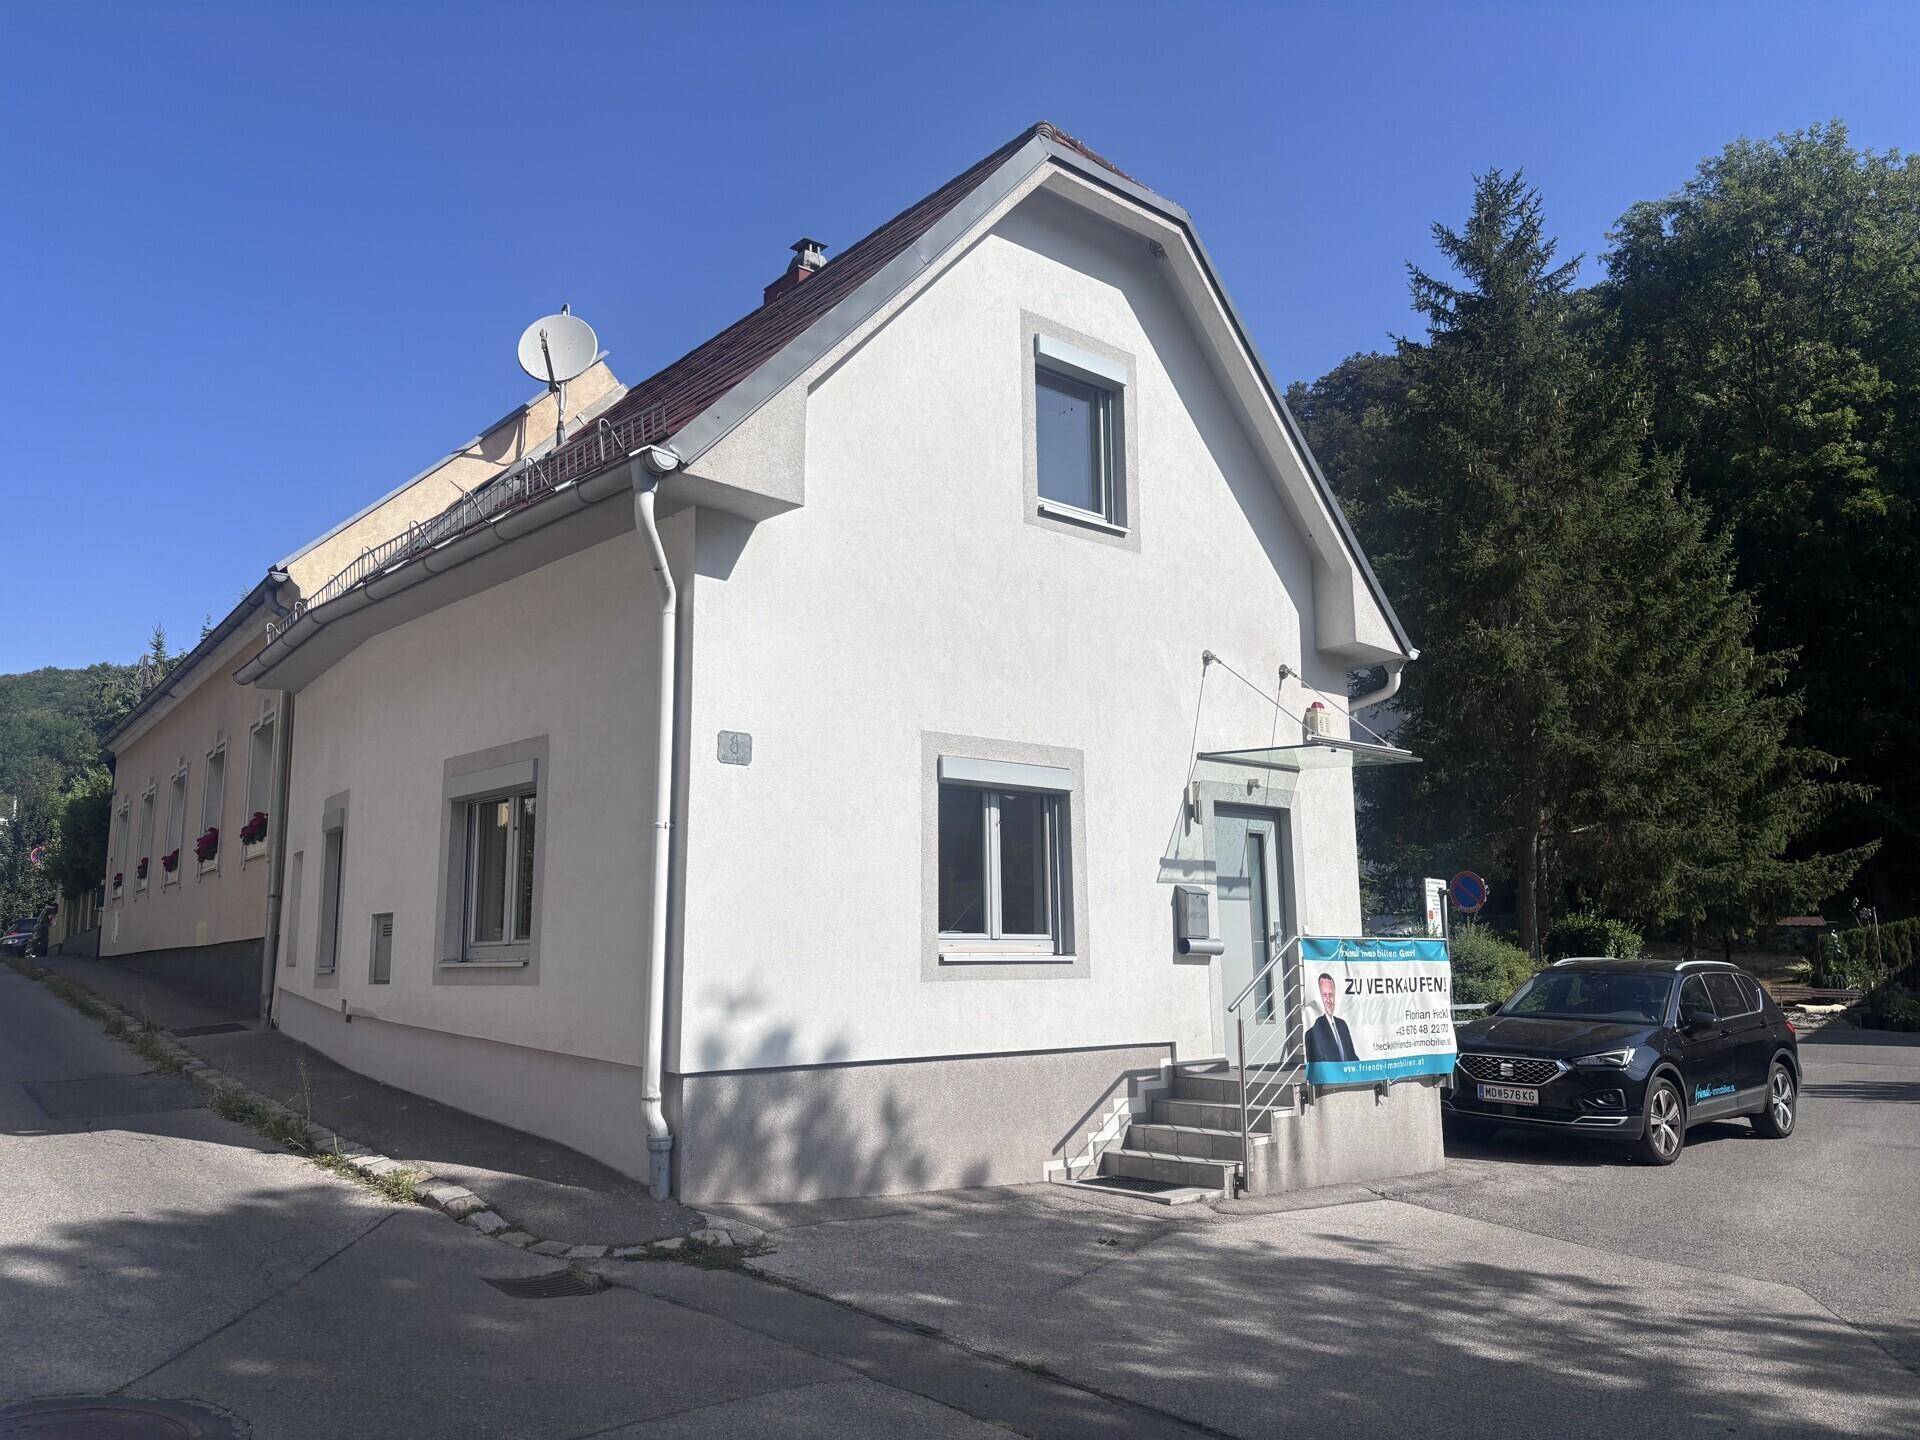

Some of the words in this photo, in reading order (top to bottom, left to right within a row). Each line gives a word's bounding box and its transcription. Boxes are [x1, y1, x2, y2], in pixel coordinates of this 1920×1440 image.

[1345, 979, 1362, 995] ZU
[1367, 977, 1447, 994] VERKAUFEN!
[1405, 1009, 1431, 1021] Florian
[1418, 1024, 1429, 1034] 48
[1485, 1087, 1497, 1098] MD
[1503, 1089, 1521, 1100] 576
[1522, 1090, 1535, 1101] KG
